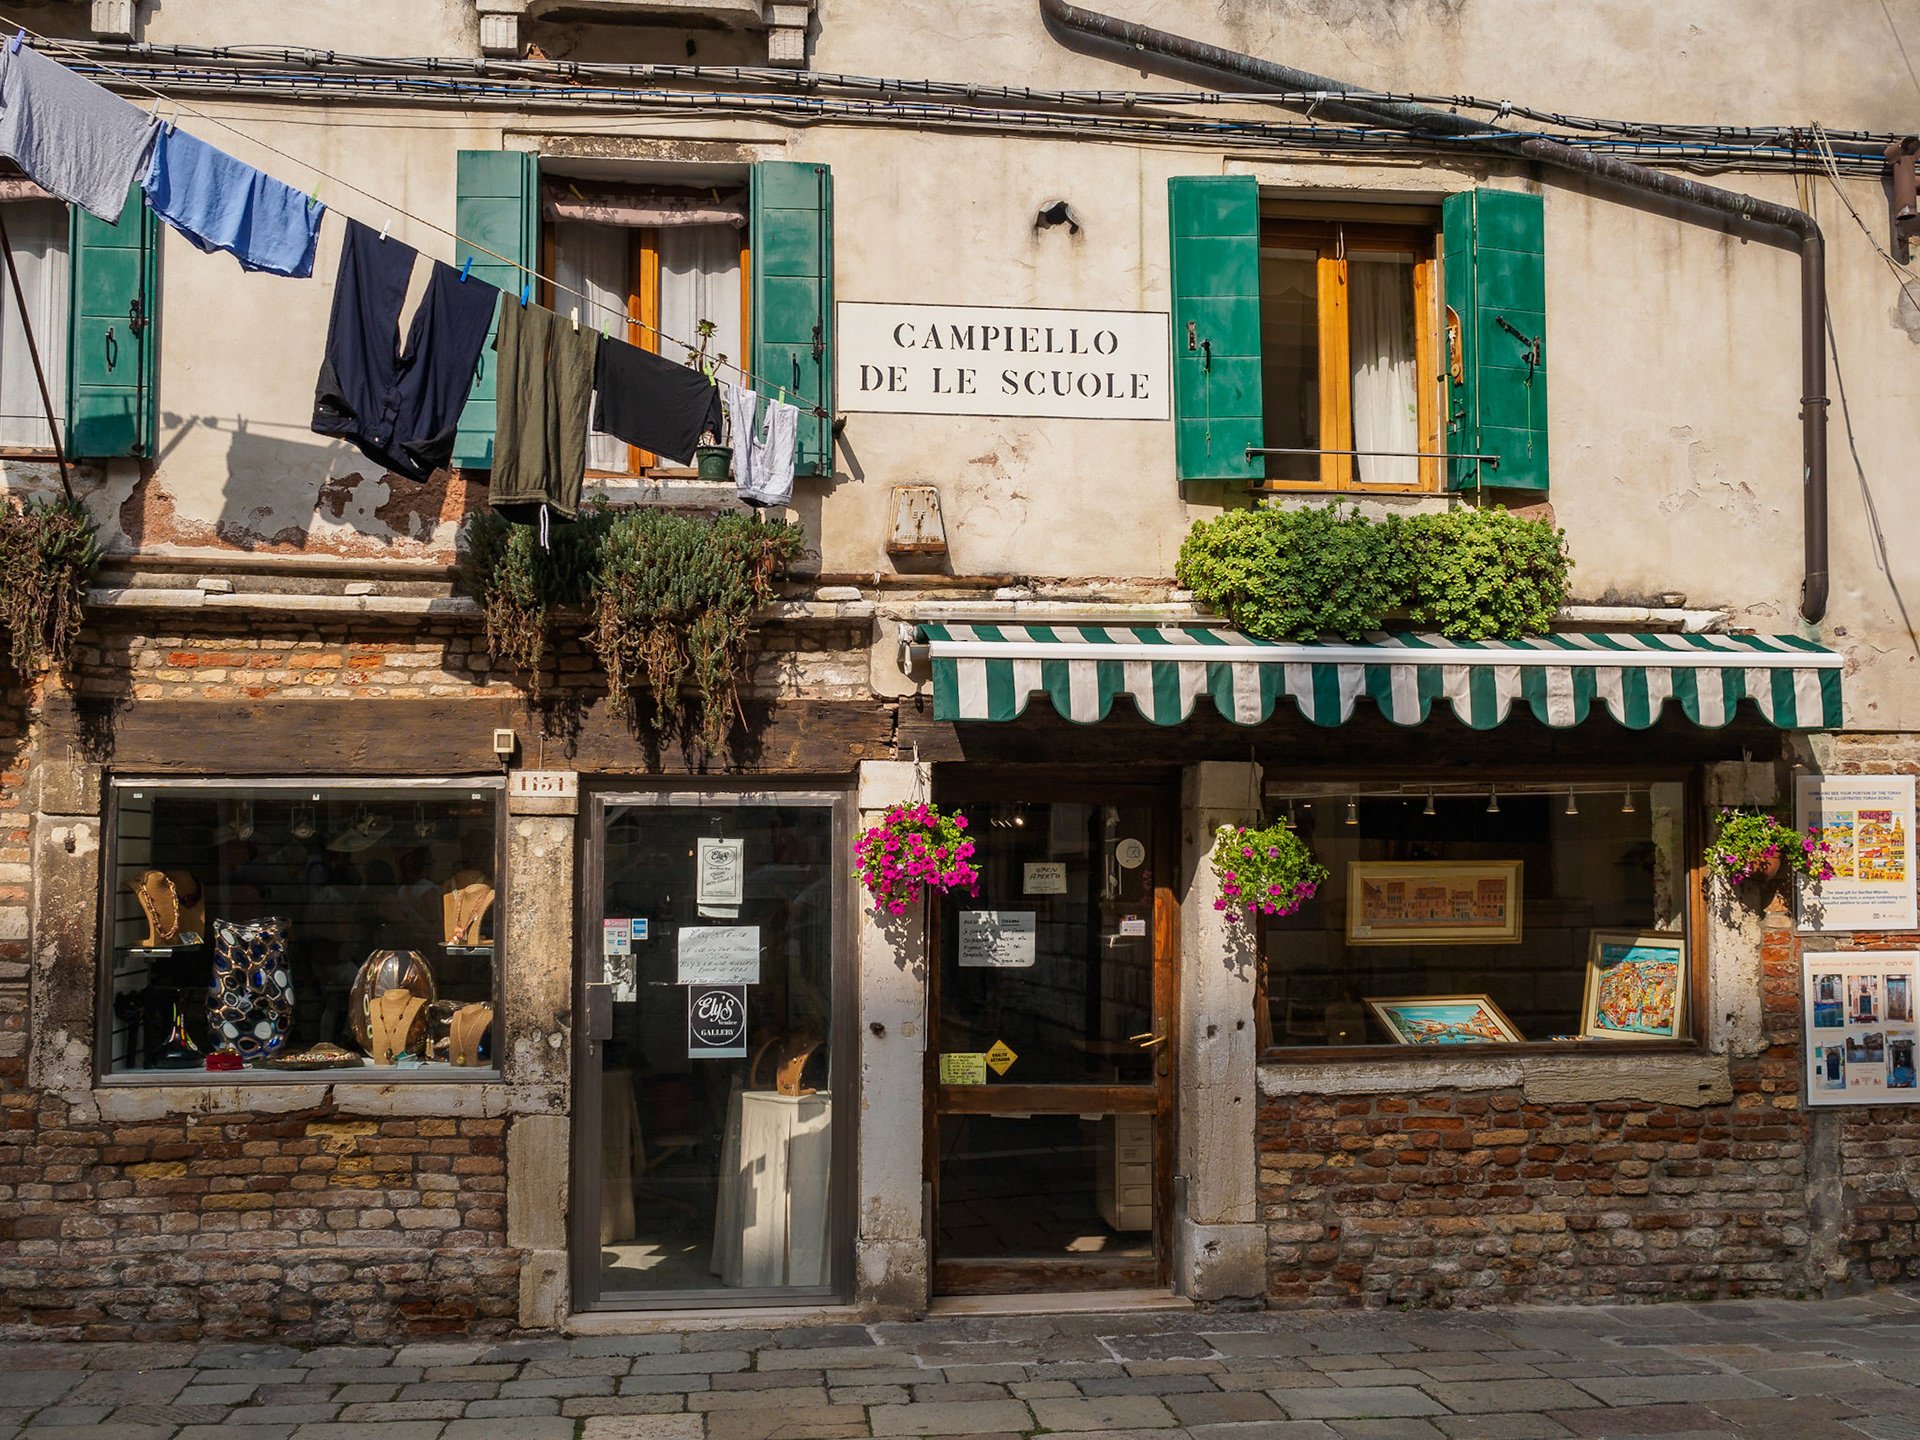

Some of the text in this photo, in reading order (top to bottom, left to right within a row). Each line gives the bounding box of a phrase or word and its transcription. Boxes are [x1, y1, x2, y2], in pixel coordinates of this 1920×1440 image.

[893, 322, 1119, 356] CAMPIELLO
[859, 364, 1150, 400] DE LE SCUOLE
[698, 995, 734, 1022] Ely's
